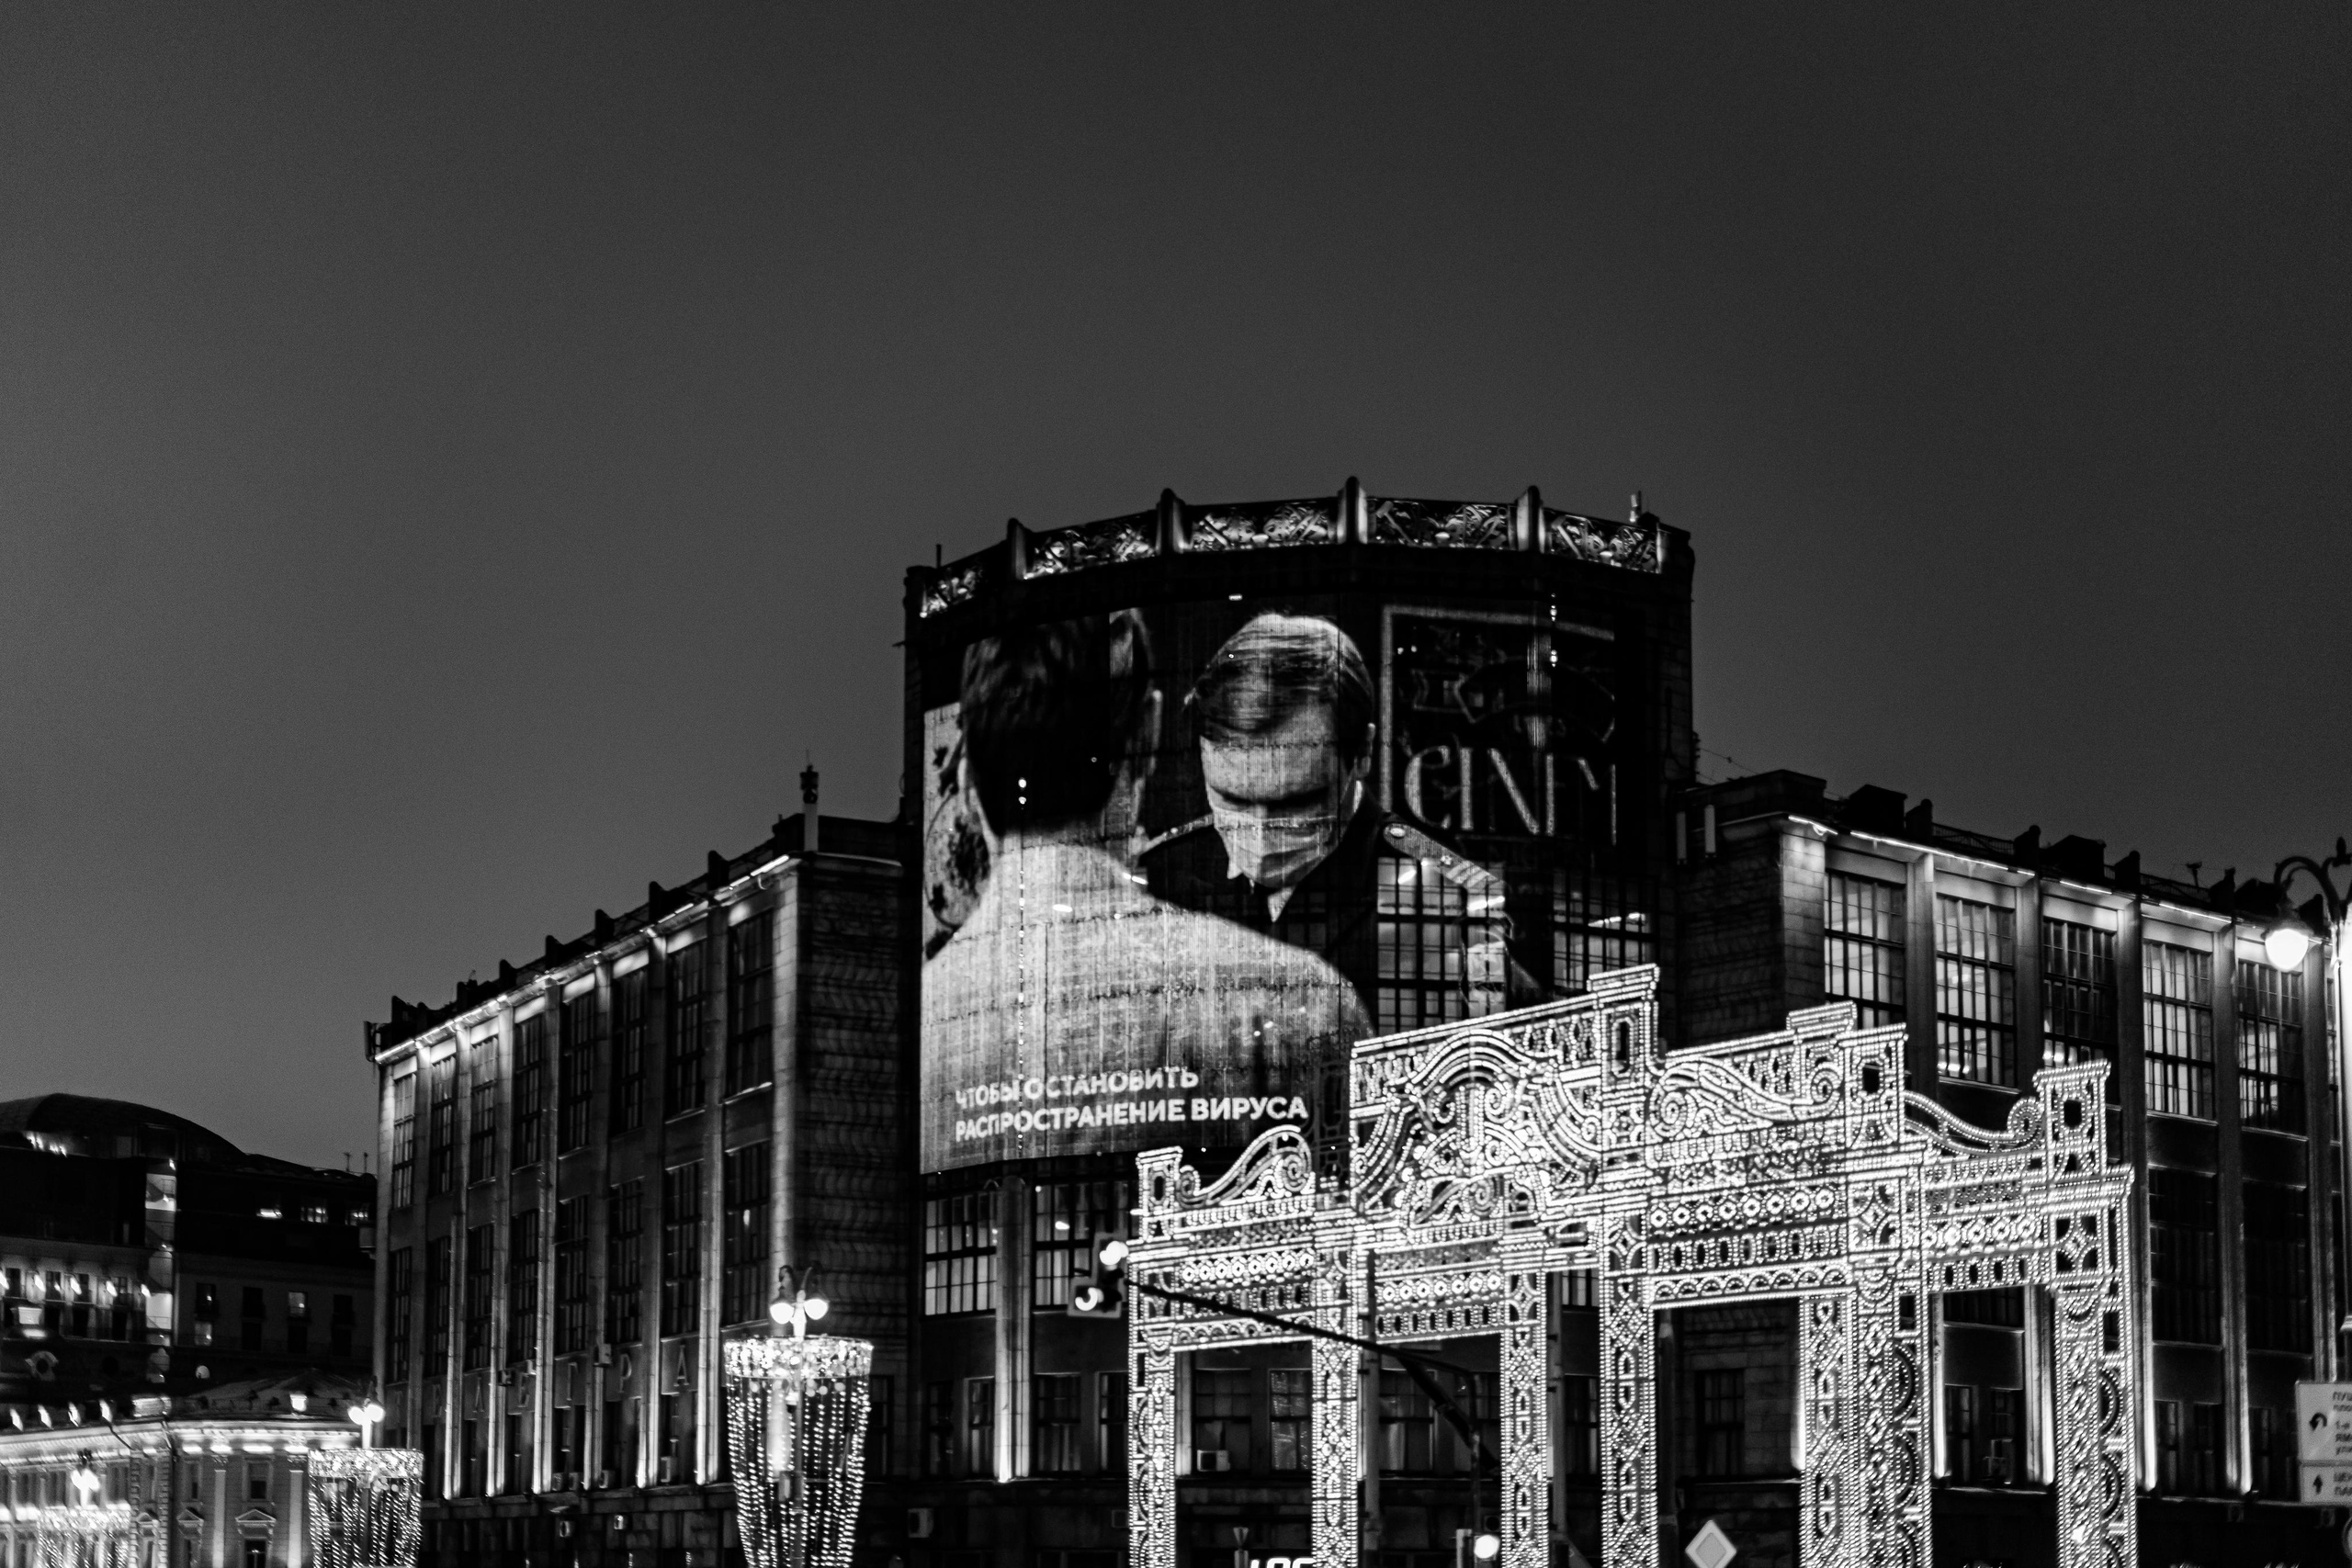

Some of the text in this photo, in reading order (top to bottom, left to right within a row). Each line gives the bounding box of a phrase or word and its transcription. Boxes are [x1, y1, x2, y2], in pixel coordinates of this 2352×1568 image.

[955, 1066, 1199, 1111] ЧТОБЫ ОСТАНОВИТЬ
[956, 1096, 1309, 1142] РАСПРОСТРАНЕНИЕ ВИРУСА
